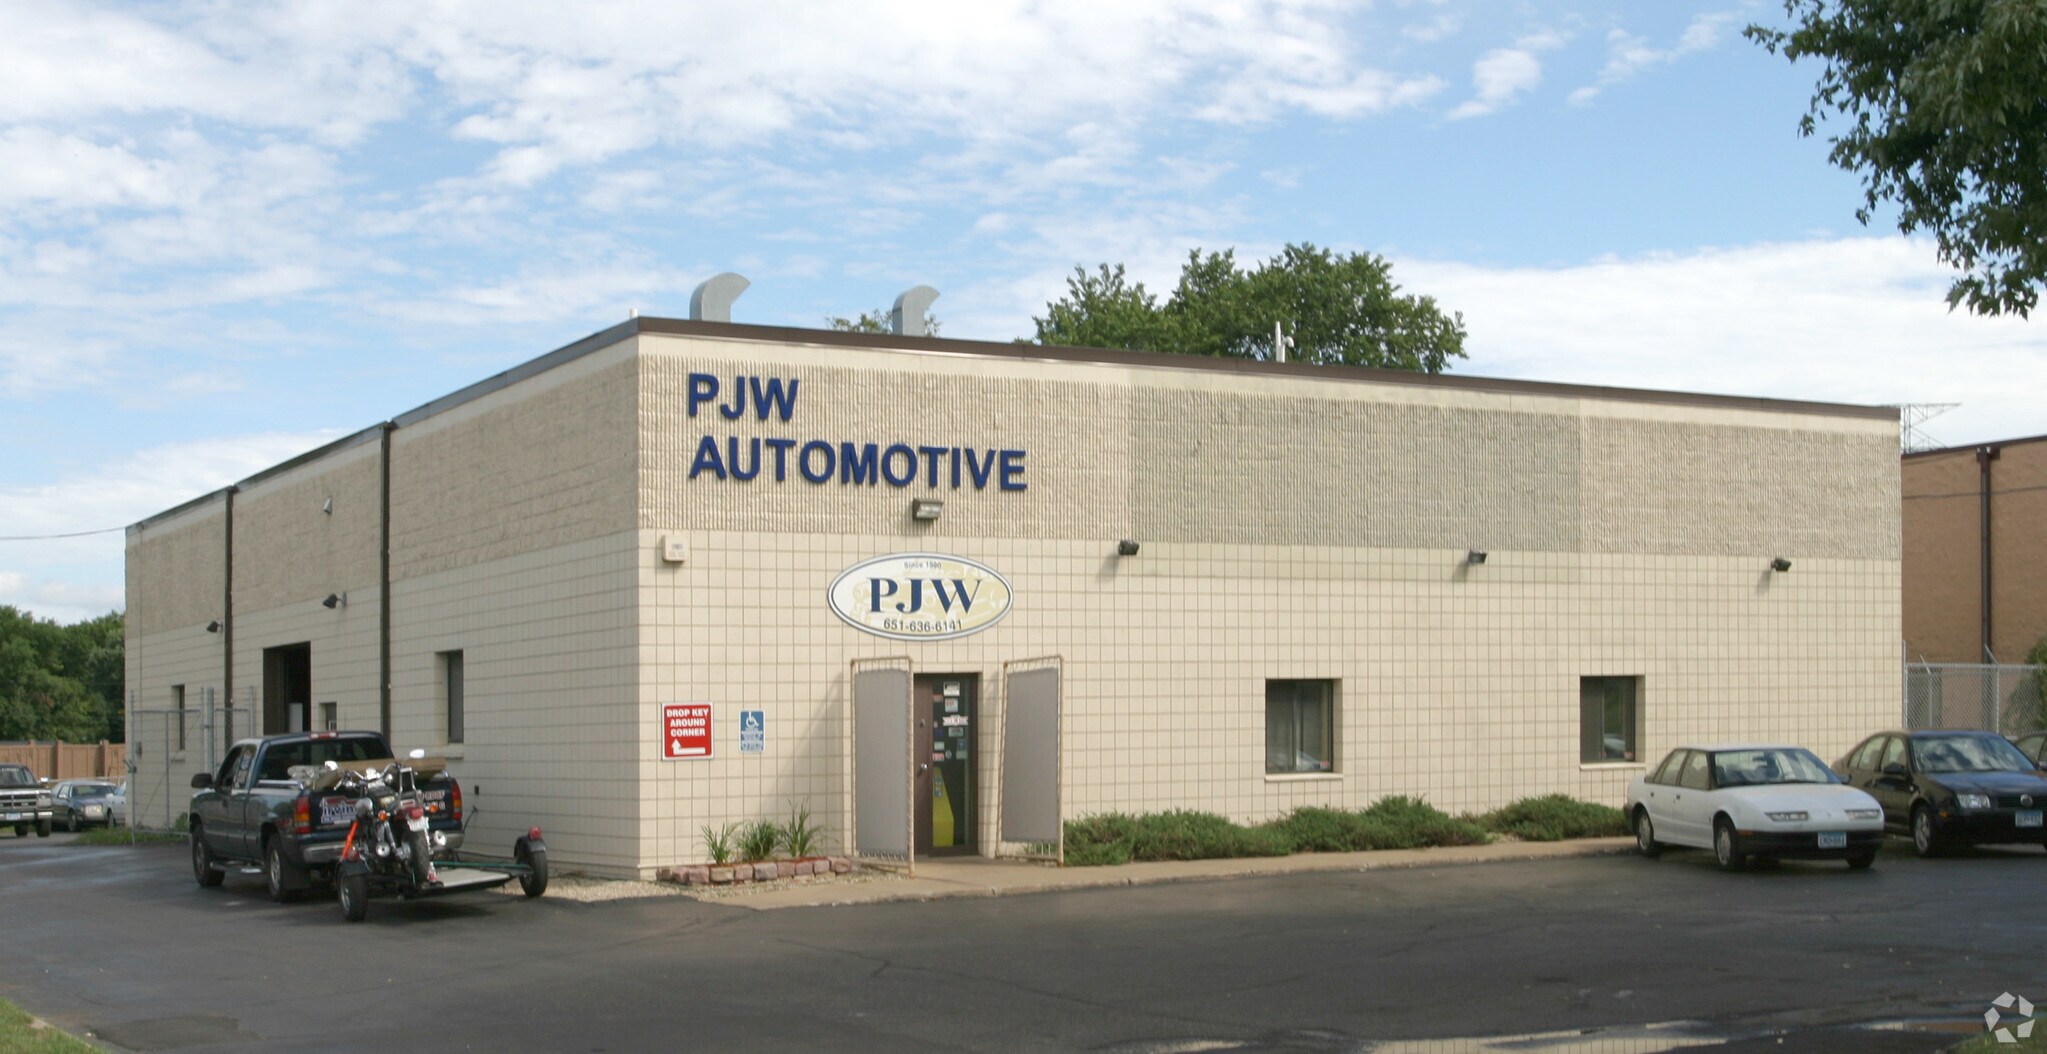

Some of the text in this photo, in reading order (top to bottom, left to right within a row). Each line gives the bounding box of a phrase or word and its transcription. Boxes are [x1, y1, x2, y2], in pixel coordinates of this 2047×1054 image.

[689, 373, 799, 421] PJW
[689, 435, 1028, 491] AUTOMOTIVE
[904, 560, 924, 569] Since
[867, 577, 981, 614] PJW
[883, 618, 962, 632] 651-636-6141
[666, 707, 709, 718] DROP KEY
[670, 718, 706, 727] AROUND
[670, 728, 706, 737] CORNER
